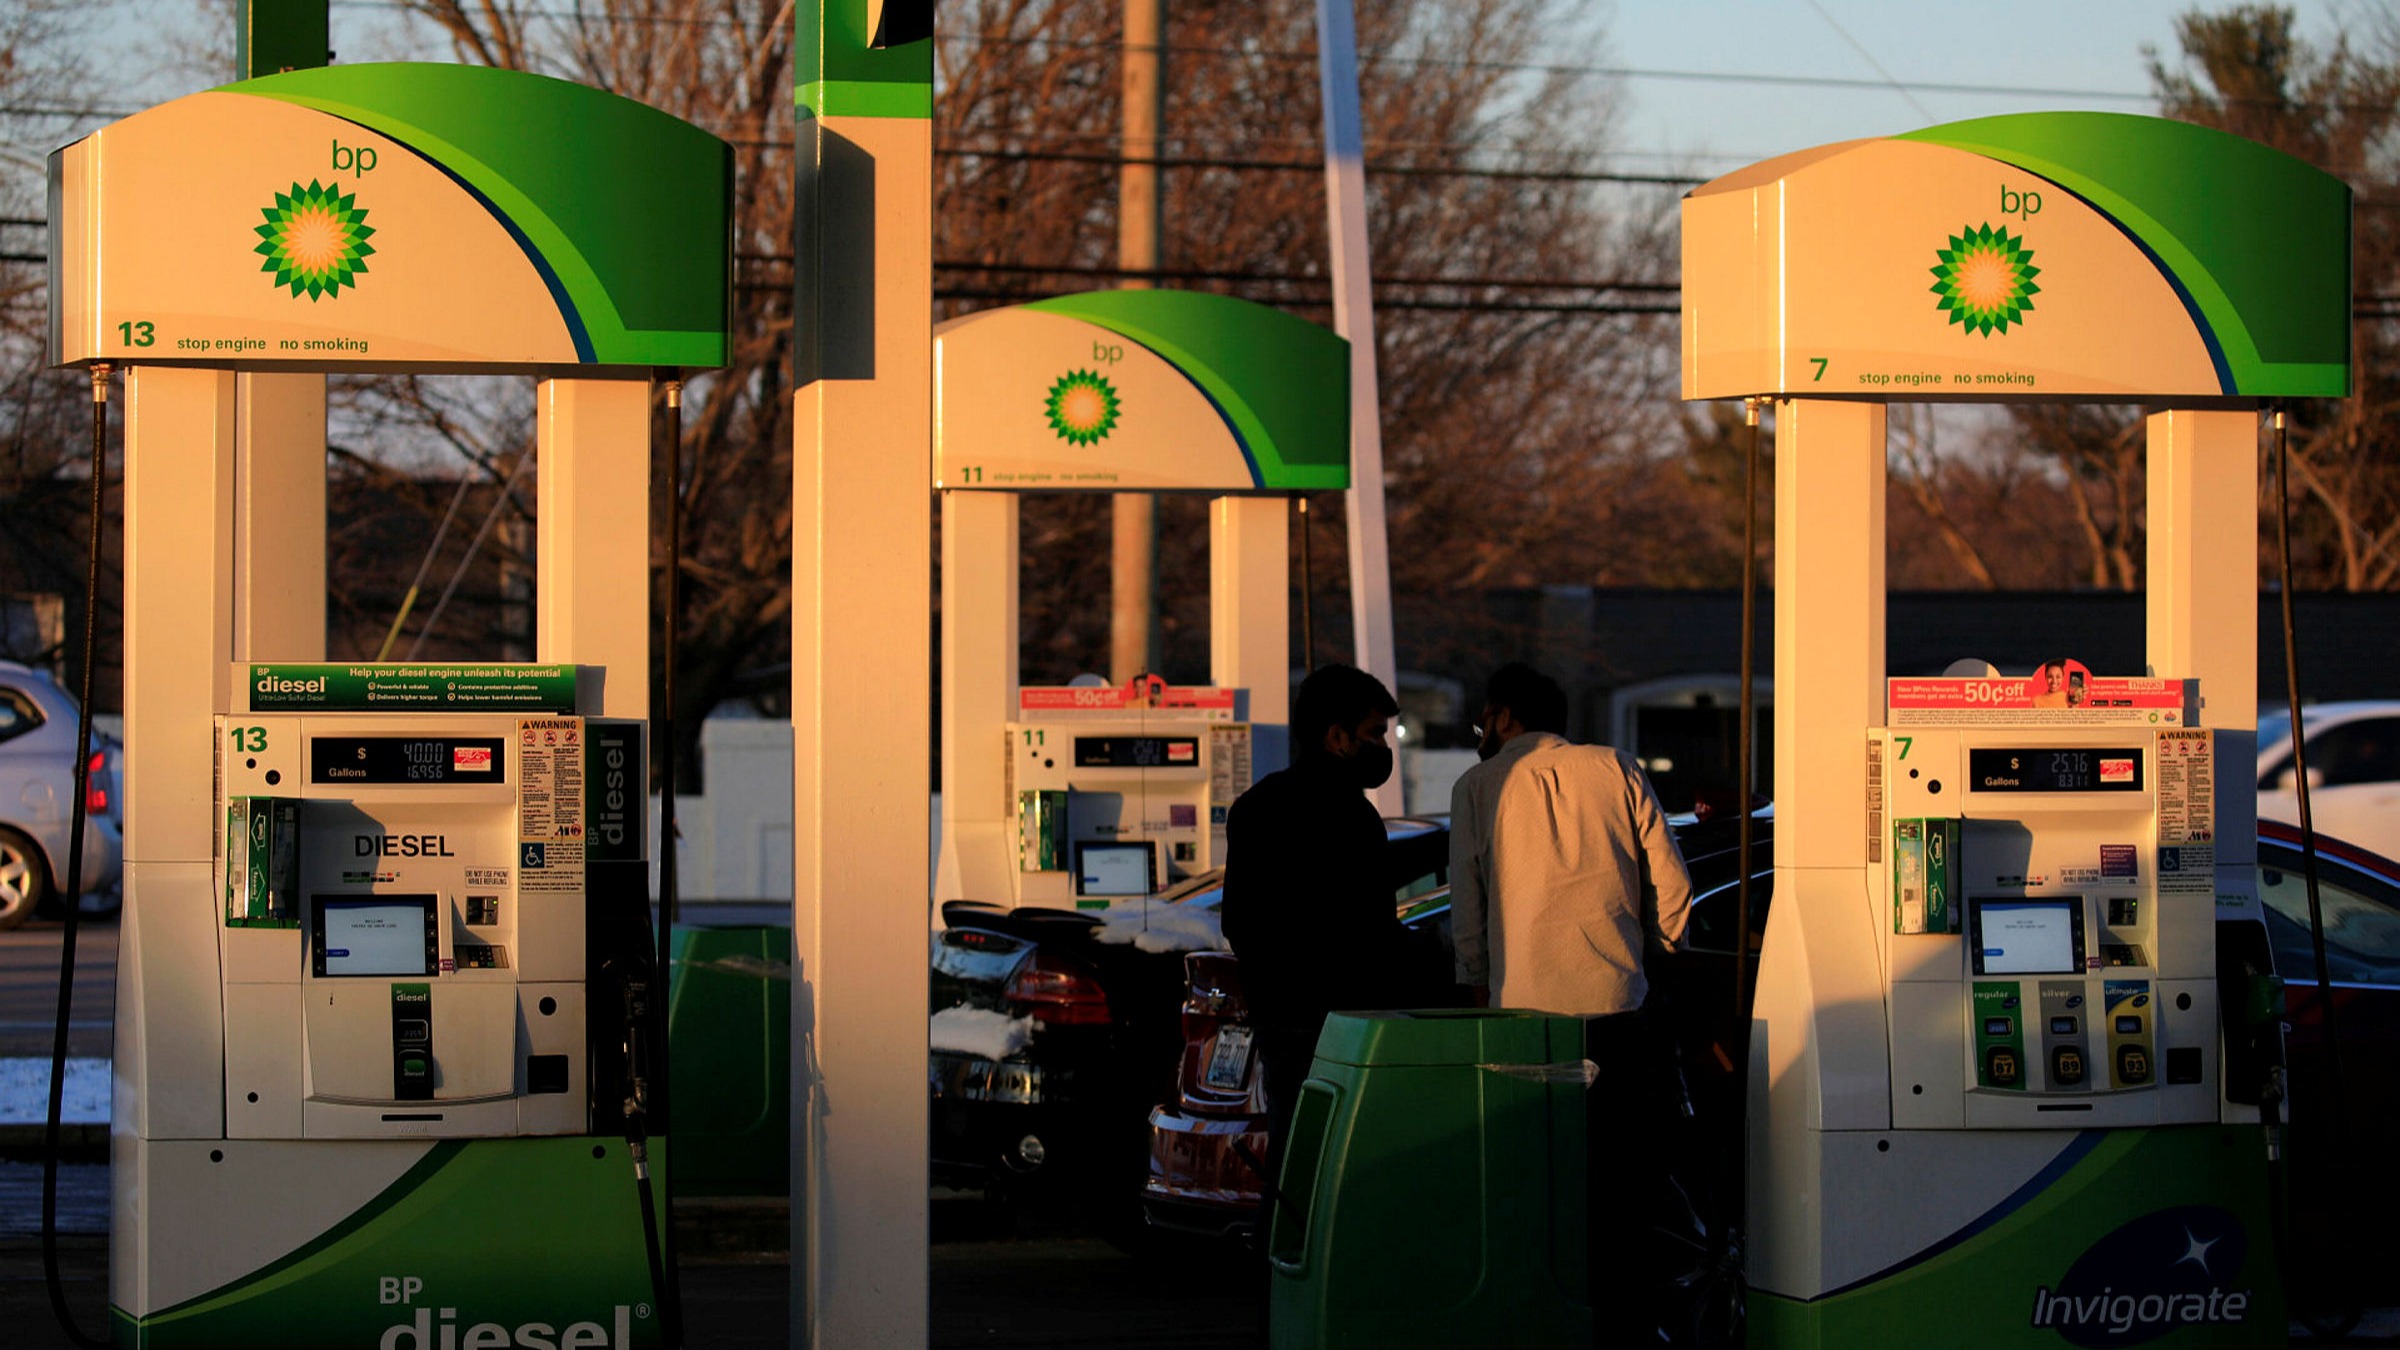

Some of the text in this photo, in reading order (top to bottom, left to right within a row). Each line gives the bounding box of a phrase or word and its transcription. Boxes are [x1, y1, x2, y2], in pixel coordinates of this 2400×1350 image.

[331, 139, 378, 178] bp
[2000, 184, 2042, 221] bp
[118, 321, 155, 347] 13
[177, 337, 368, 353] stop engine no smoking
[1093, 341, 1123, 367] bp
[1809, 357, 1828, 382] 7
[1859, 371, 2035, 387] stop engine no smoking
[962, 467, 982, 483] 11
[257, 667, 270, 676] BP
[349, 668, 561, 679] Help your diesel engine unleash its potential
[257, 676, 325, 693] diesel
[1965, 682, 2025, 706] 50¢ off
[530, 720, 576, 730] WARNING
[231, 728, 268, 752] 13
[1024, 730, 1045, 745] 11
[2167, 731, 2207, 741] WARNING
[357, 746, 366, 760] $
[1893, 737, 1913, 760] 7
[2010, 757, 2019, 770] $
[329, 767, 367, 777] Gallons
[1985, 776, 2020, 786] Gallons
[600, 739, 624, 845] diesel
[587, 827, 599, 846] BP
[355, 835, 454, 857] DIESEL
[396, 993, 427, 1002] diesel
[1974, 990, 2009, 1000] regular
[2042, 989, 2070, 998] silver
[1995, 1063, 2012, 1073] 87
[2062, 1061, 2078, 1072] 89
[2127, 1060, 2144, 1070] 93
[379, 1276, 423, 1305] BP
[2033, 1286, 2248, 1334] Invigorate
